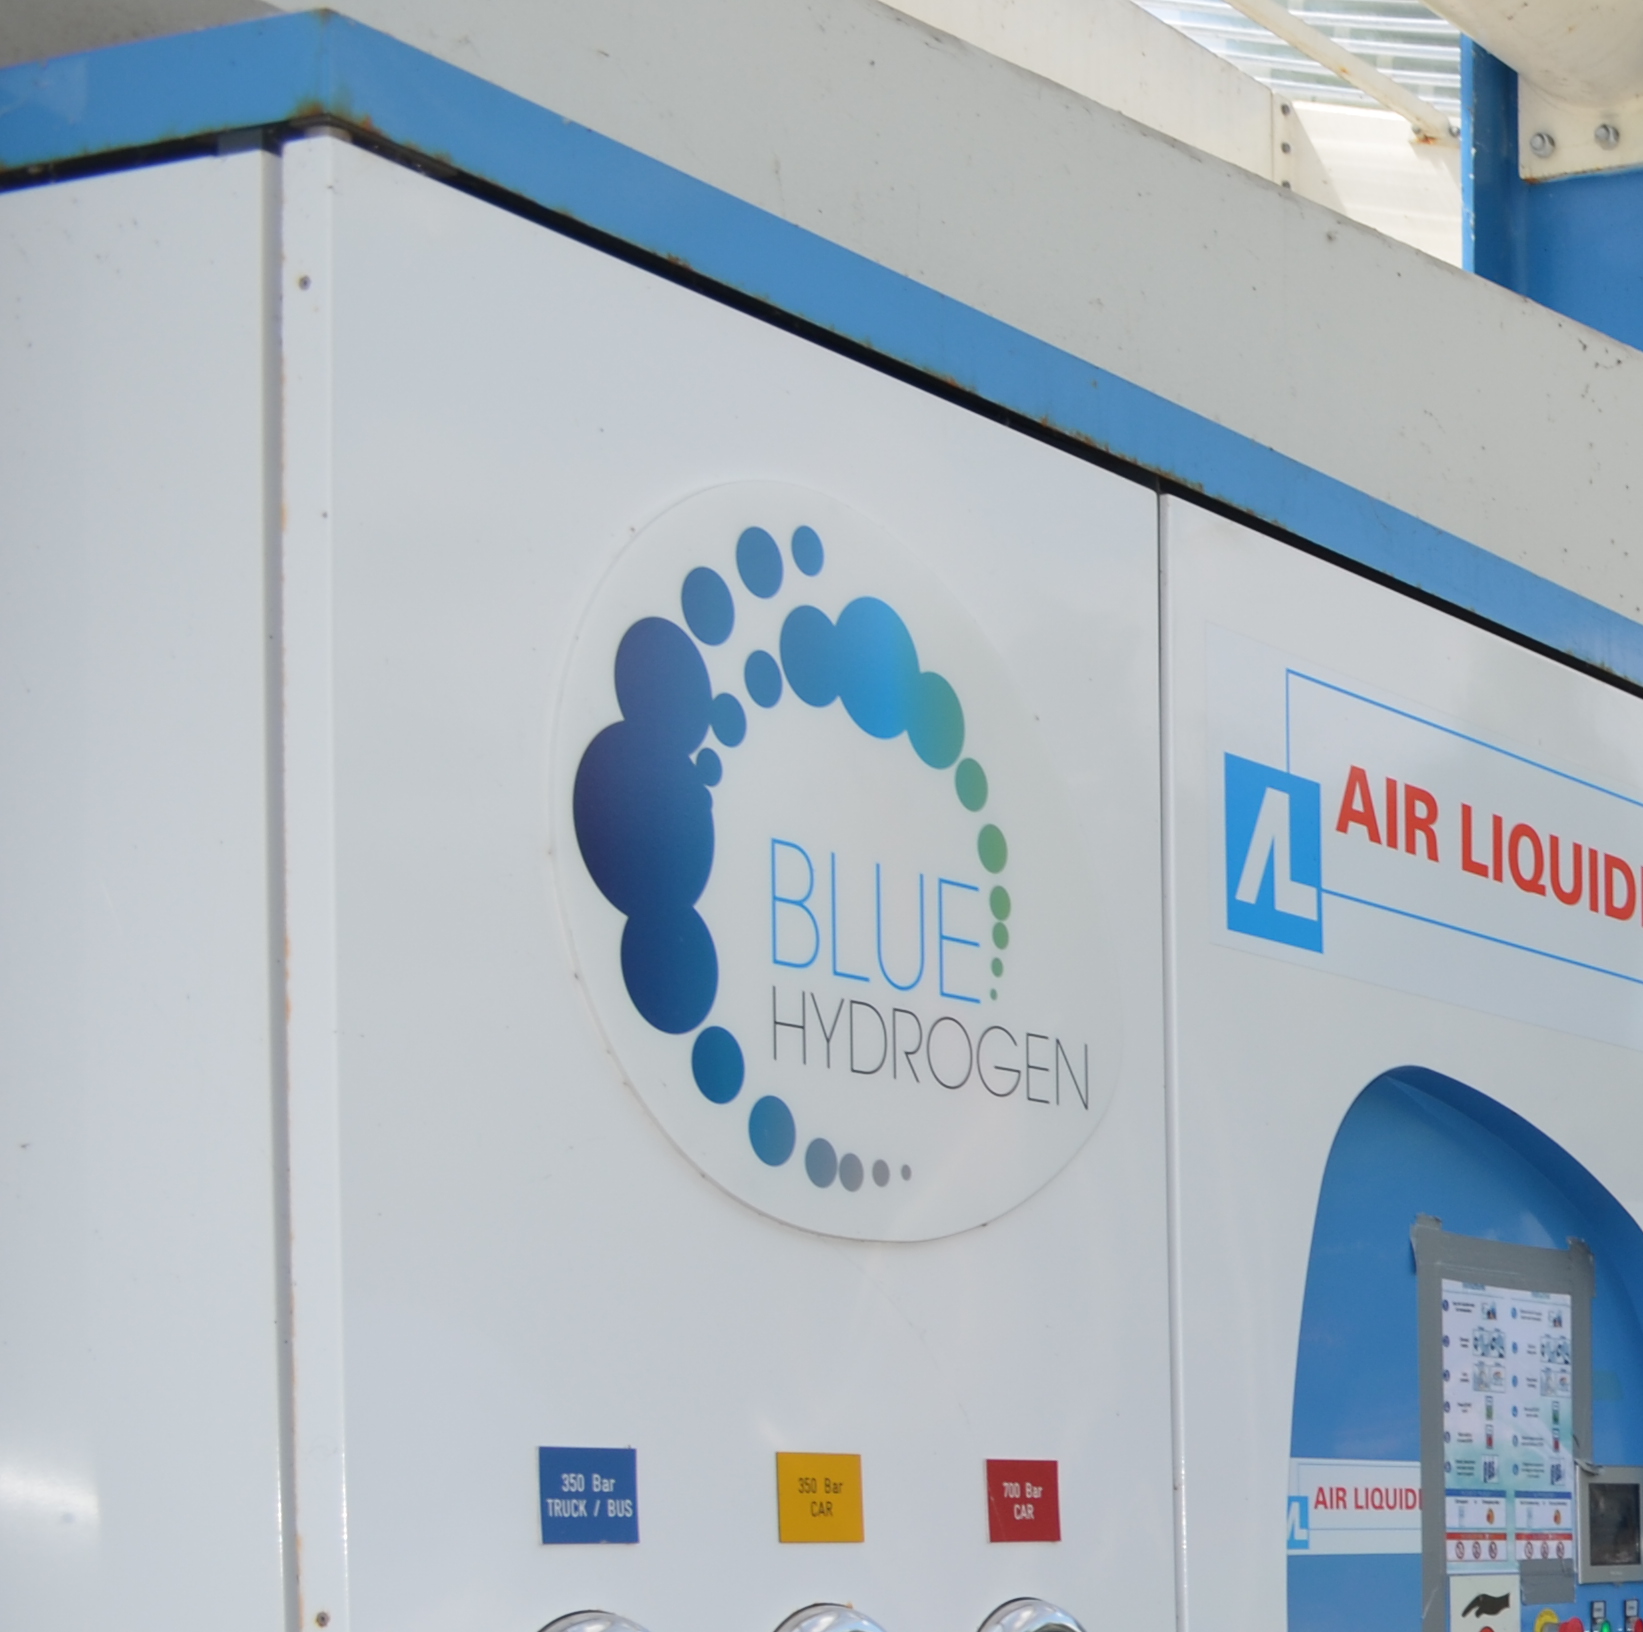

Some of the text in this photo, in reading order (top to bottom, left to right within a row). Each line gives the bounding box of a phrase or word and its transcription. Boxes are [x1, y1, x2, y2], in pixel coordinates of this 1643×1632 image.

[1336, 765, 1439, 862] AIR
[771, 837, 981, 1004] BLUE
[772, 986, 1090, 1111] HYDROGEN
[561, 1473, 616, 1492] 350 Bar
[798, 1477, 843, 1494] 350 Bar
[1002, 1482, 1043, 1498] 700 Bar
[1314, 1486, 1347, 1510] AIR
[546, 1499, 633, 1518] TRUCK / BUS
[810, 1501, 833, 1517] CAR
[1013, 1503, 1035, 1520] CAR
